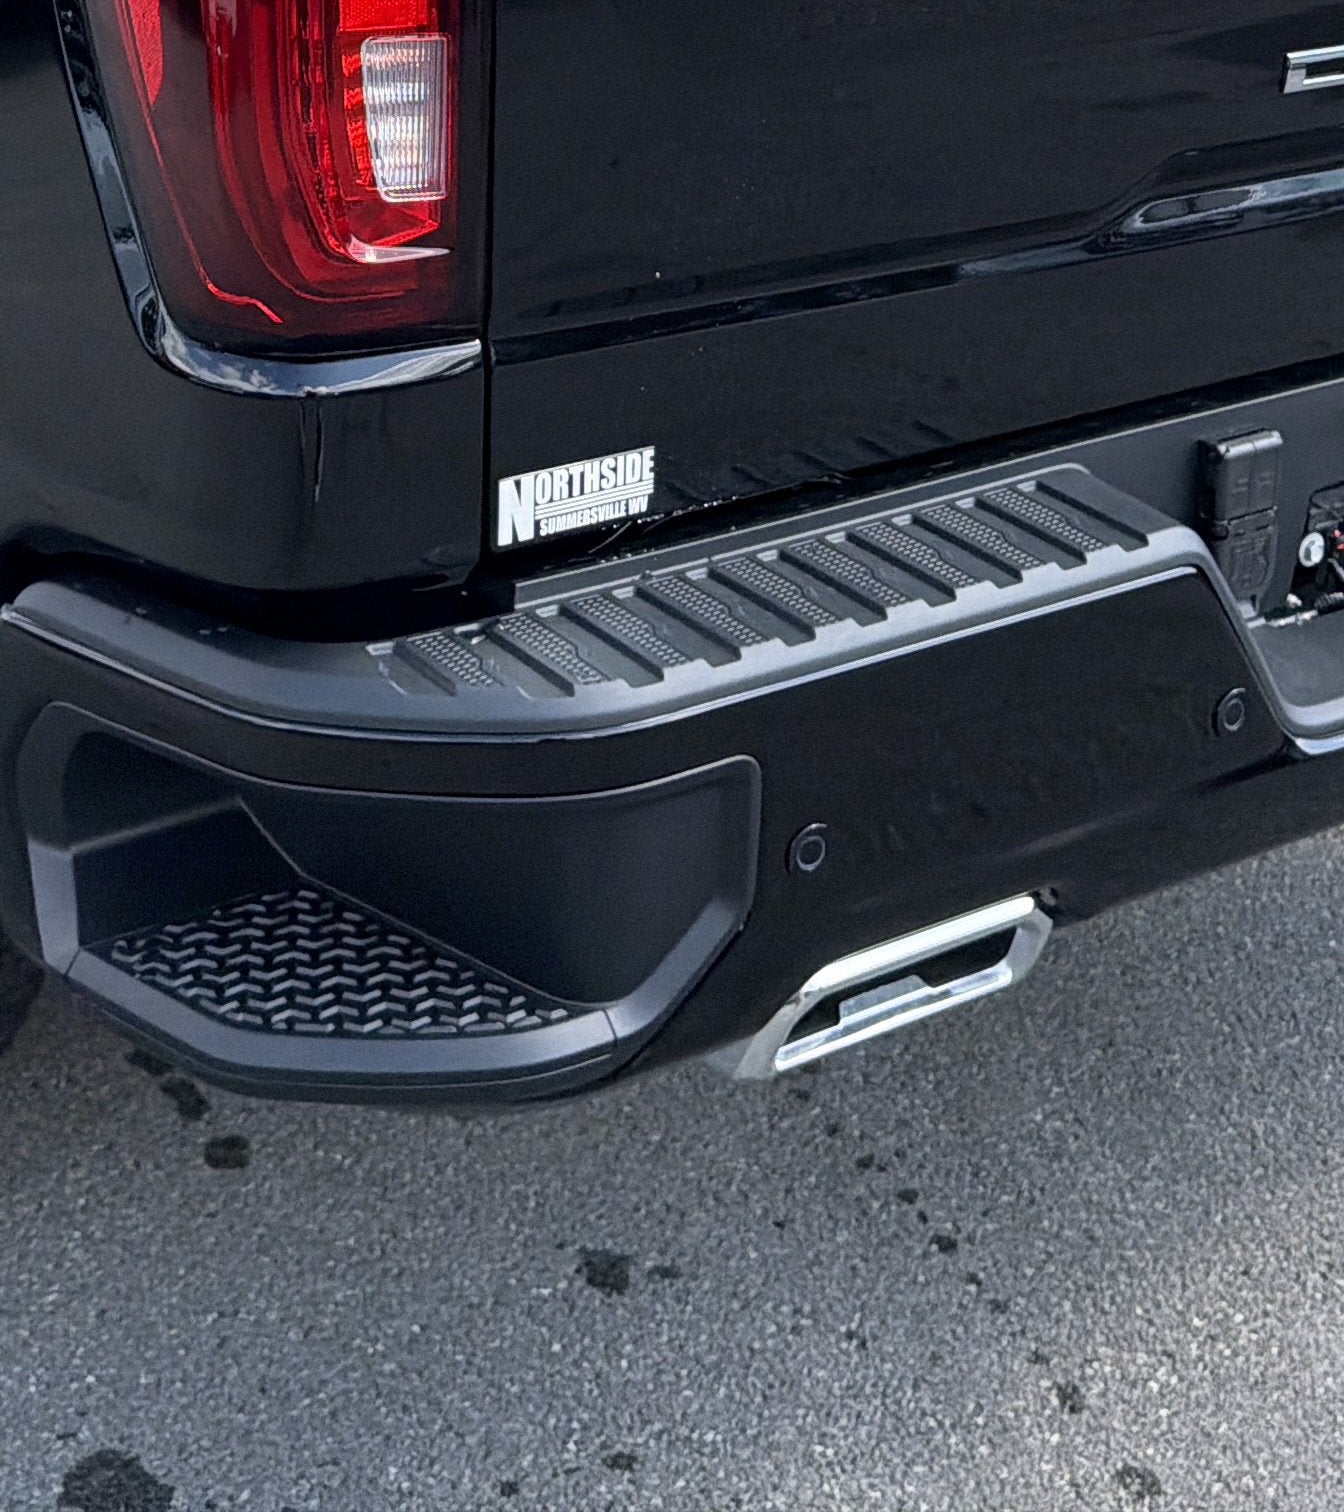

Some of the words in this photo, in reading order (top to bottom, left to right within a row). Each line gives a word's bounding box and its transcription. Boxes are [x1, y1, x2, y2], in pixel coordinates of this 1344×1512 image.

[497, 448, 655, 547] NORTHSIDE
[539, 502, 627, 537] SUMMERSVILLE
[627, 494, 649, 515] WV
